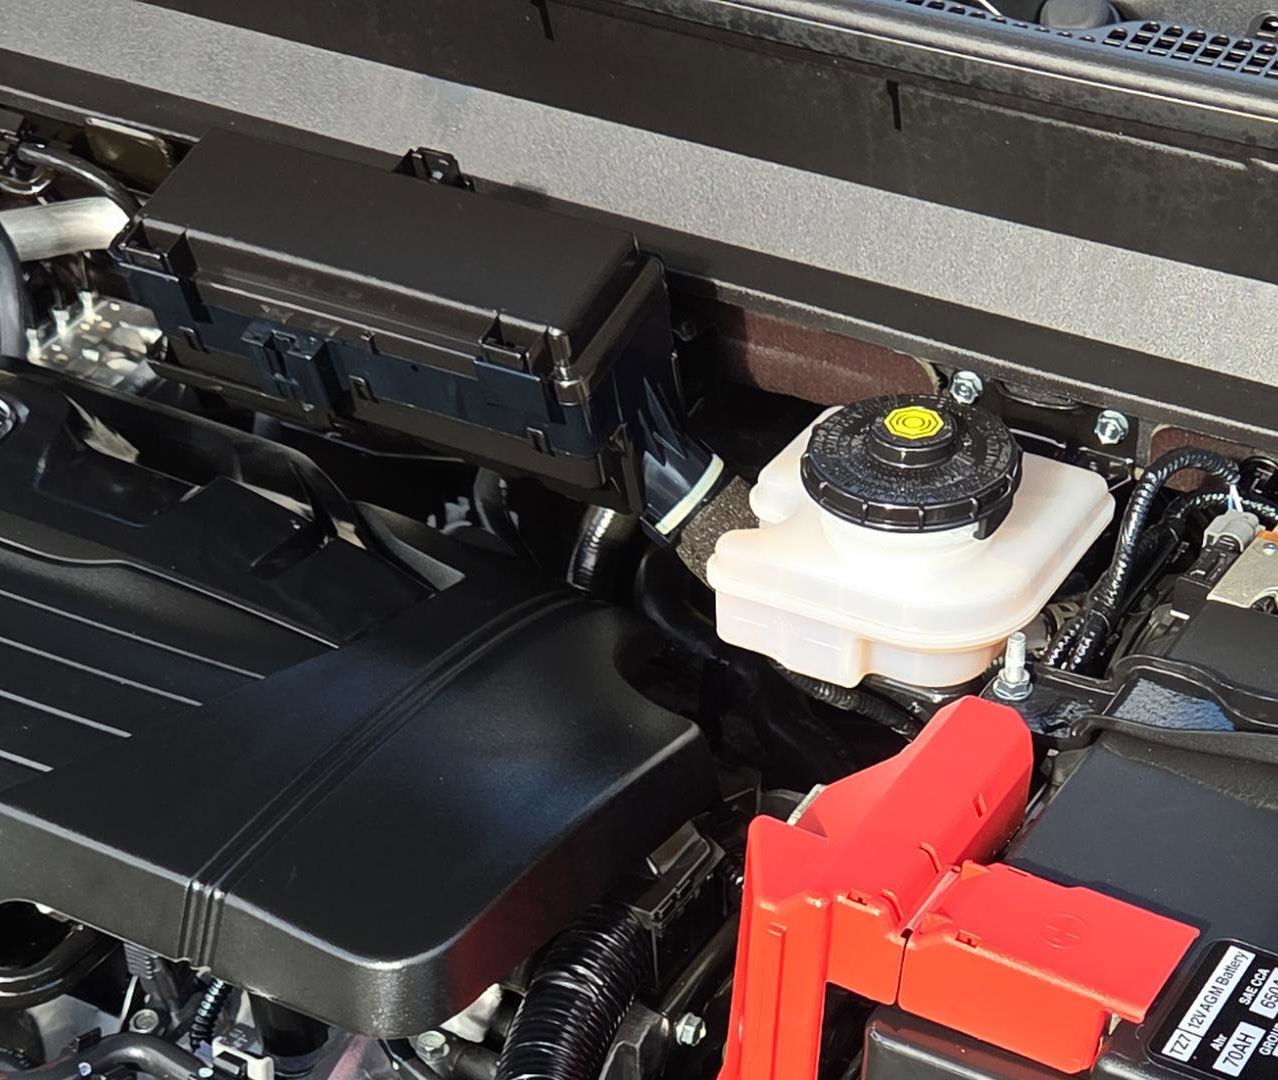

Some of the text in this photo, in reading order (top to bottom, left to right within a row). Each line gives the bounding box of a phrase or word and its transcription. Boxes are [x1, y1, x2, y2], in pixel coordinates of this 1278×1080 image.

[1169, 951, 1249, 1055] TZ7 12V AGM Battery
[1238, 968, 1270, 1006] SAE CCA
[1210, 1033, 1228, 1051] Ahr
[1222, 1032, 1256, 1068] 70AH
